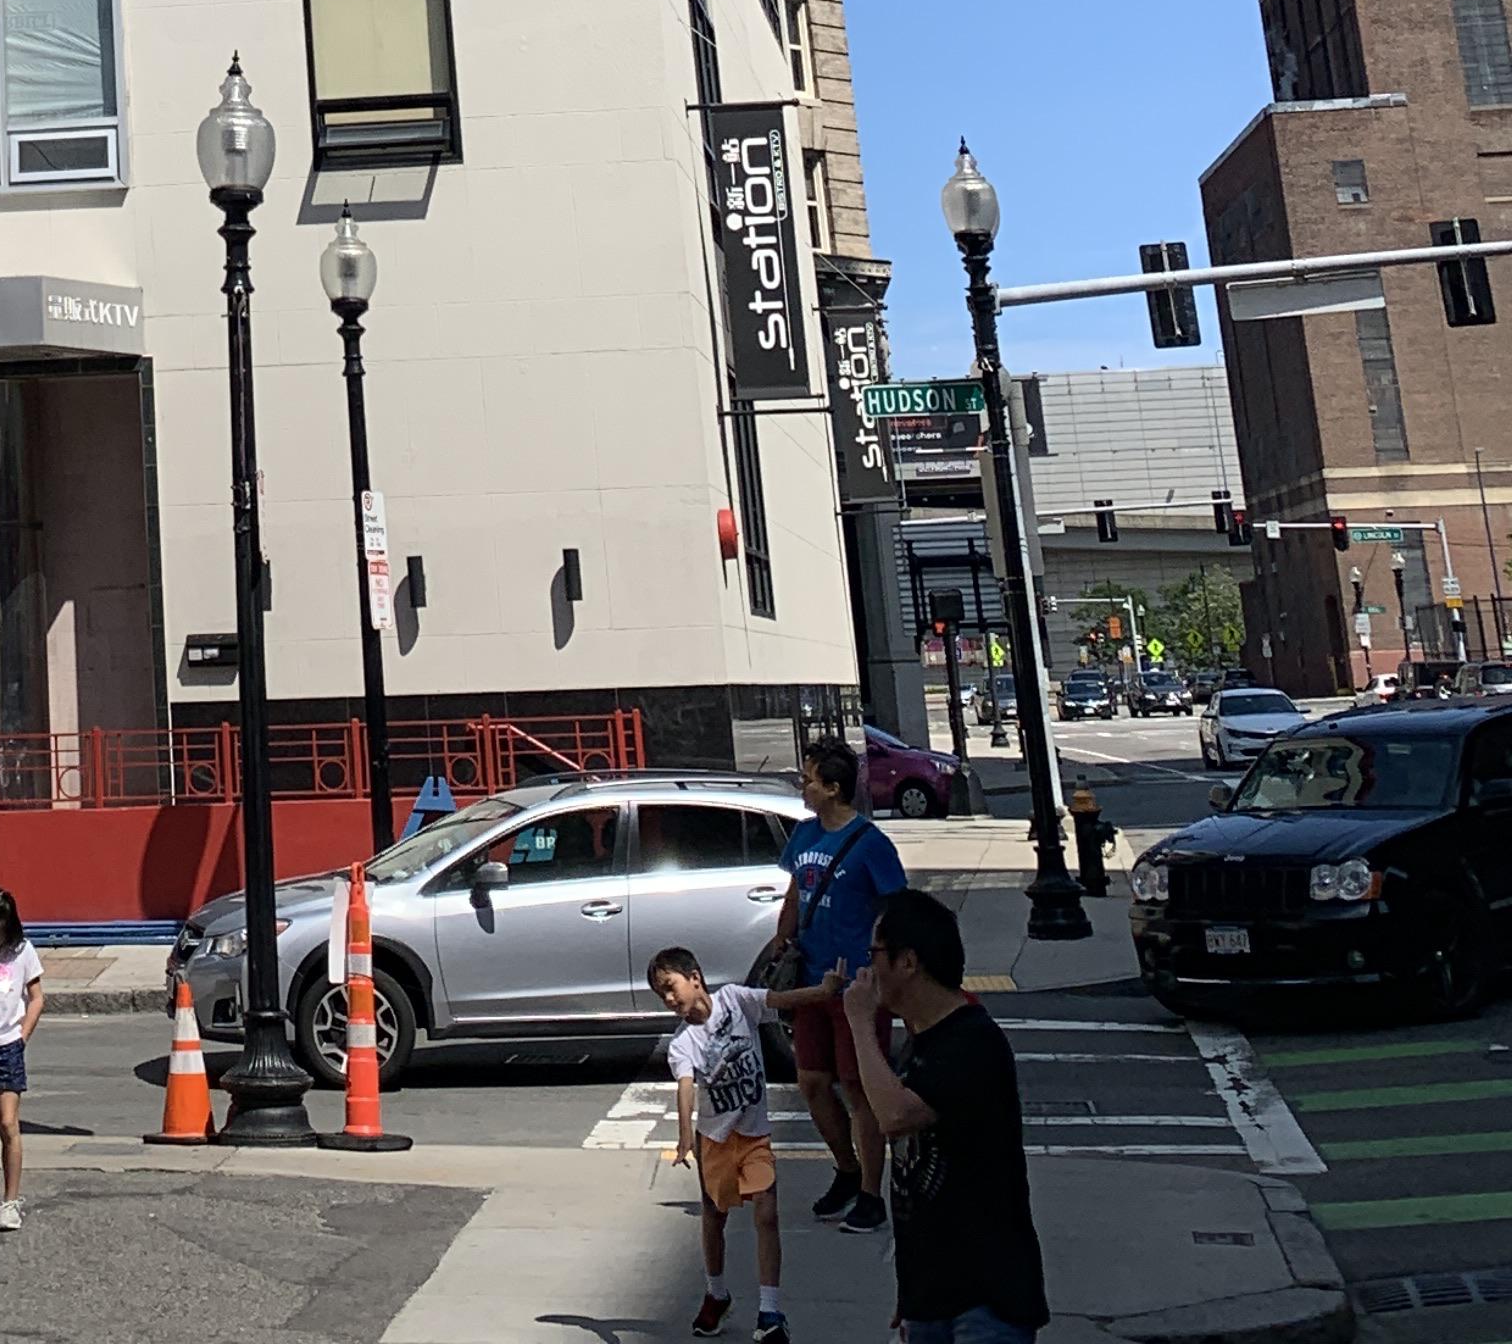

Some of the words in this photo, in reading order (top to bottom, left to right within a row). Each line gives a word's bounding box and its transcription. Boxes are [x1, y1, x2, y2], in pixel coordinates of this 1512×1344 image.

[721, 138, 745, 210] 新一站
[726, 136, 786, 350] station
[867, 387, 957, 414] HUDSON
[965, 397, 977, 410] ST
